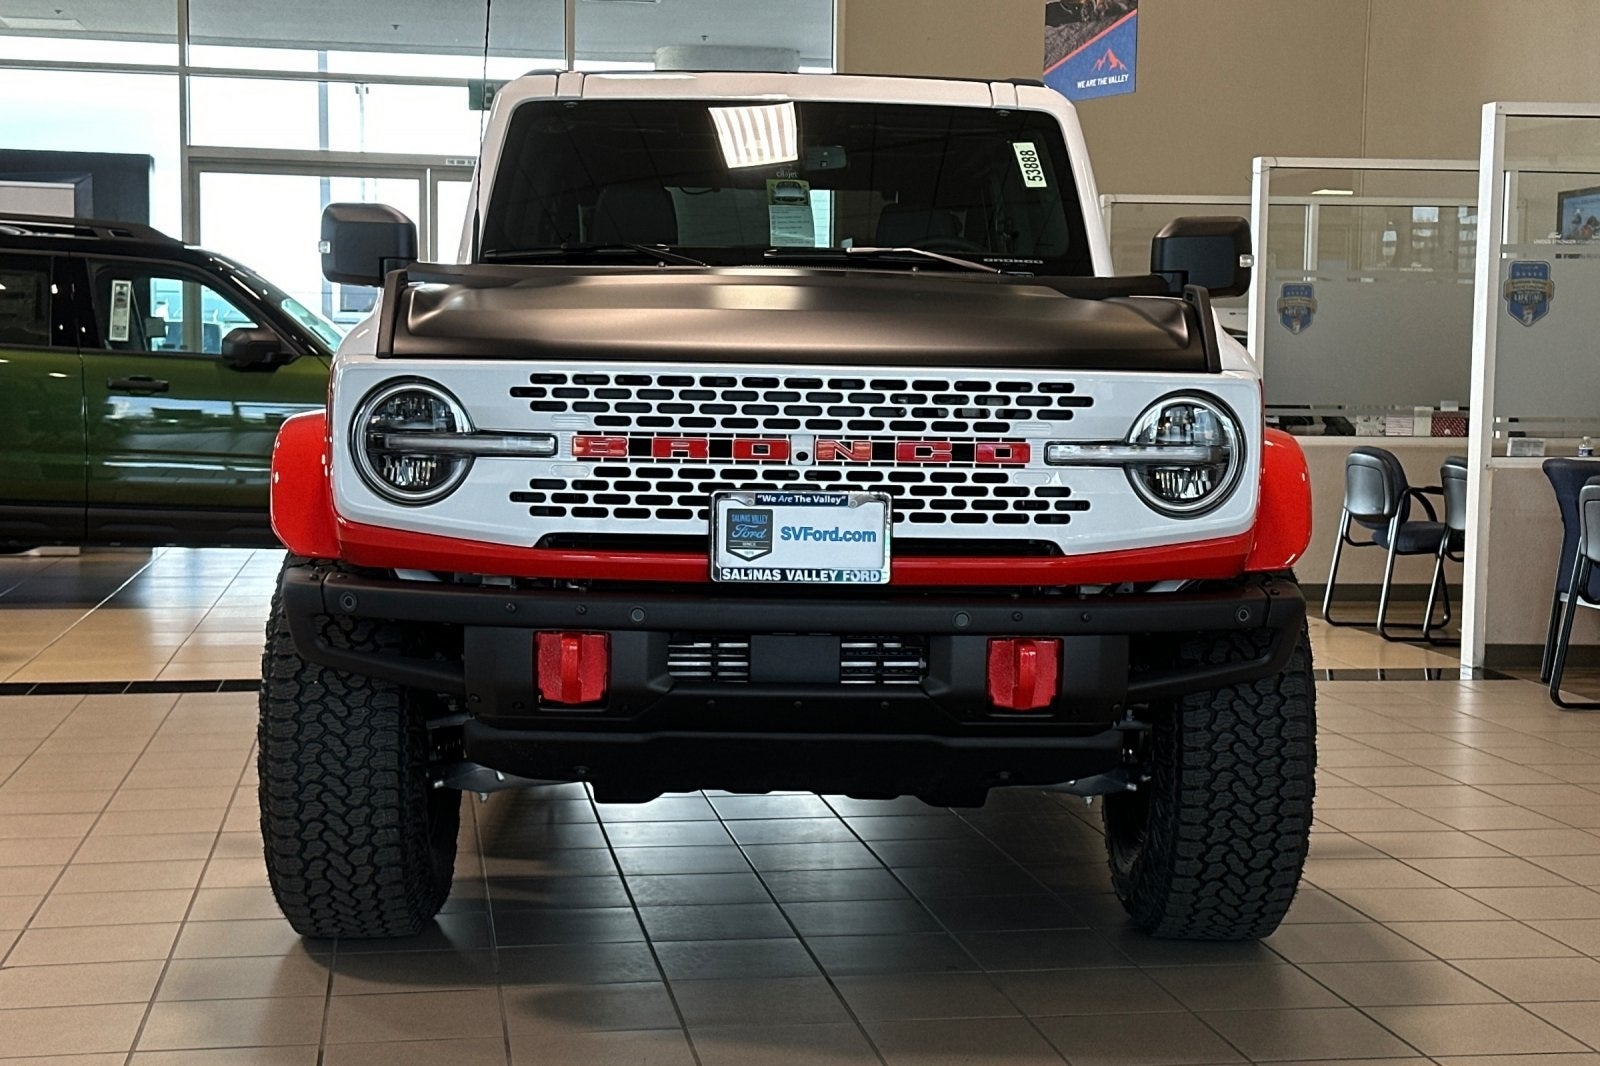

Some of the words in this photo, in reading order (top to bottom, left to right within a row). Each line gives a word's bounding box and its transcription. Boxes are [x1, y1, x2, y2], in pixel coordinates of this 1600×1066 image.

[1077, 80, 1085, 89] WE
[1086, 79, 1096, 87] ARE
[1098, 78, 1107, 86] THE
[1108, 74, 1129, 84] VALLEY
[1020, 149, 1043, 182] 53888
[571, 435, 1031, 464] BRONCO
[778, 495, 793, 503] Are
[794, 495, 811, 503] The
[732, 524, 767, 538] Ford
[780, 527, 877, 542] SVFord.com
[722, 569, 781, 581] SALINAS
[786, 569, 838, 582] VALLEY
[843, 570, 880, 582] FORD
